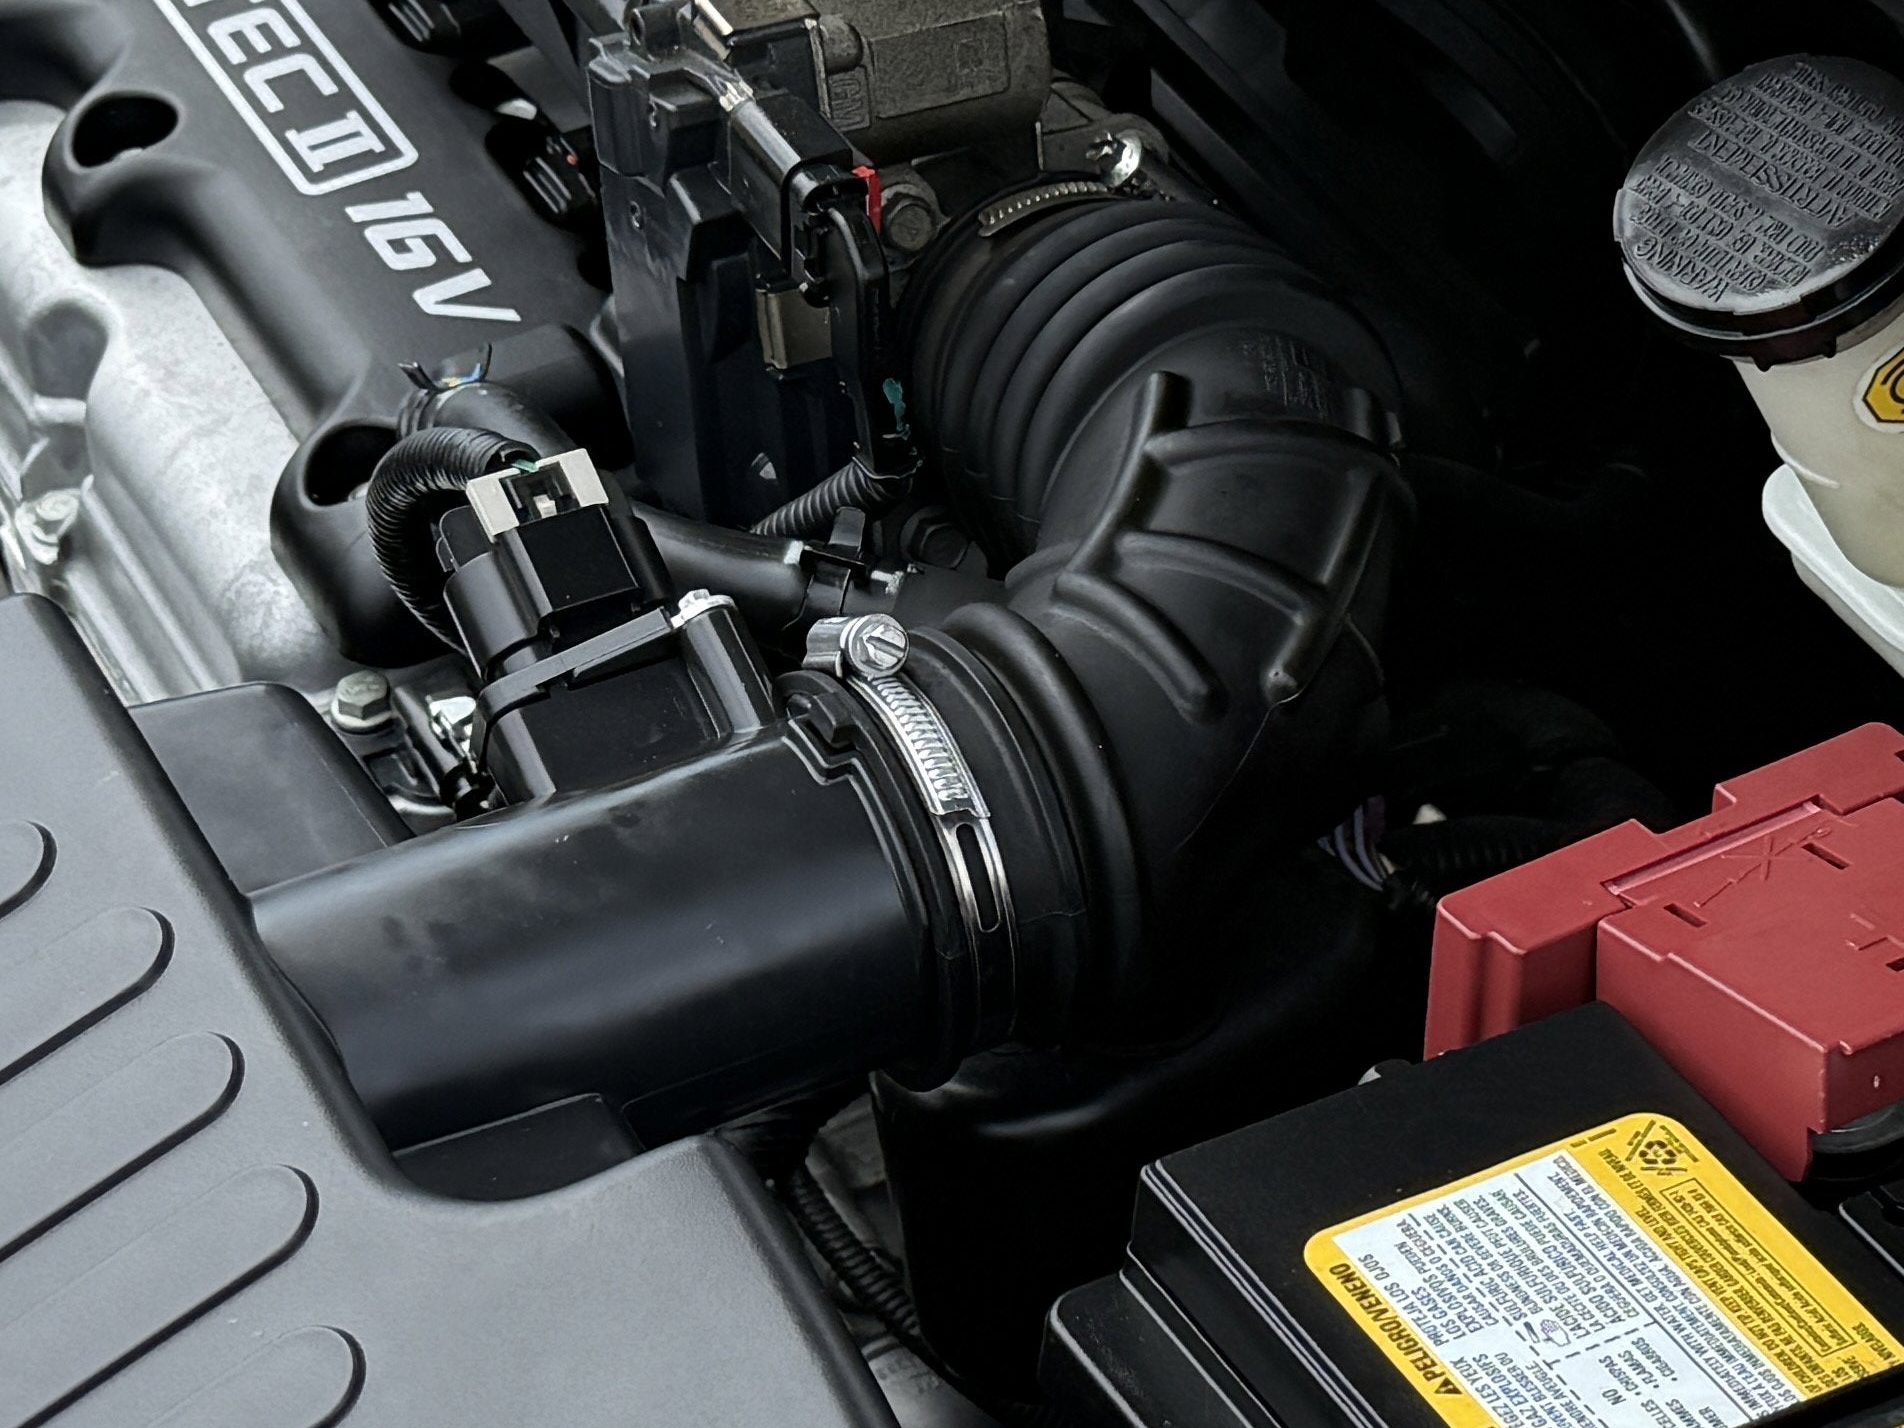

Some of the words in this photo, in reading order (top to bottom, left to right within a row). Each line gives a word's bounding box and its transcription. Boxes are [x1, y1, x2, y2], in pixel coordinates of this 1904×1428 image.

[1581, 1229, 1609, 1251] HELP
[1357, 1252, 1391, 1281] OJOS
[1458, 1253, 1489, 1278] ACID
[1497, 1247, 1560, 1305] SULFURIQUE
[1601, 1250, 1643, 1287] MEDICAL
[1382, 1280, 1411, 1303] LOS
[1409, 1285, 1448, 1320] GASES
[1479, 1275, 1528, 1321] SULFURIC
[1635, 1285, 1658, 1303] GET
[1327, 1259, 1446, 1383] PELIGRO/VENENO
[1400, 1300, 1450, 1347] PROTEJA
[1461, 1291, 1500, 1327] CAUSAR
[1439, 1317, 1467, 1340] LOS
[1587, 1320, 1606, 1332] LA
[1680, 1332, 1710, 1357] WITH
[1449, 1355, 1484, 1385] YEUX
[1471, 1351, 1528, 1407] EXPLOSIFS
[1597, 1354, 1639, 1392] CHISPAS
[1616, 1348, 1658, 1385] FLAMAS
[1473, 1382, 1501, 1404] LES
[1506, 1363, 1548, 1402] BLESSER
[1600, 1387, 1626, 1406] NO
[1518, 1404, 1548, 1428] GAZ
